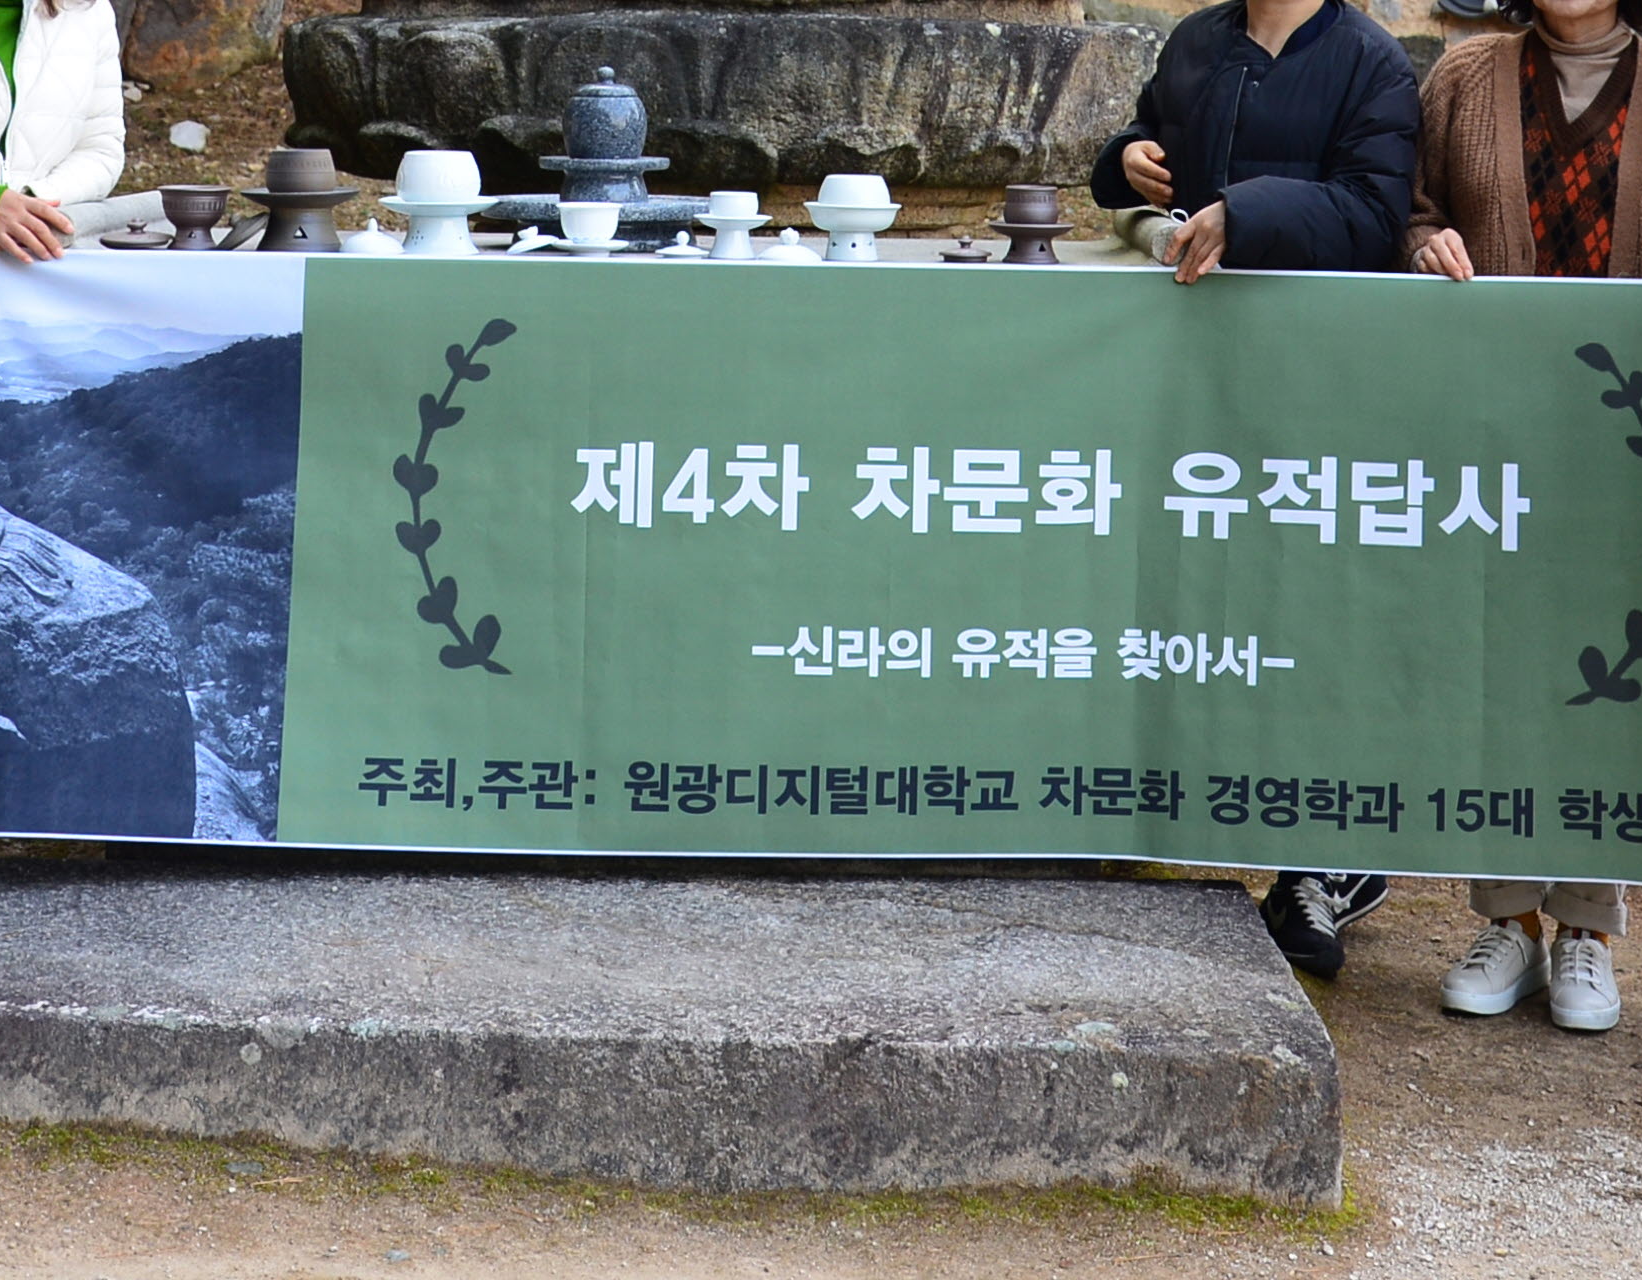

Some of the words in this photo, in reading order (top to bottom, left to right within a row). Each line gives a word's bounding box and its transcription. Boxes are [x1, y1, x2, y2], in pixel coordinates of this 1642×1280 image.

[570, 441, 810, 532] 제4차
[851, 446, 1123, 536] 차문화
[1163, 451, 1531, 553] 유적답사
[951, 626, 1099, 680] 유적을
[357, 756, 598, 812] 주최,주관:
[622, 760, 1020, 816] 원광디지털대학교
[1039, 765, 1186, 821] 차문화
[1204, 773, 1406, 833] 경영학과
[1426, 786, 1535, 839] 15대
